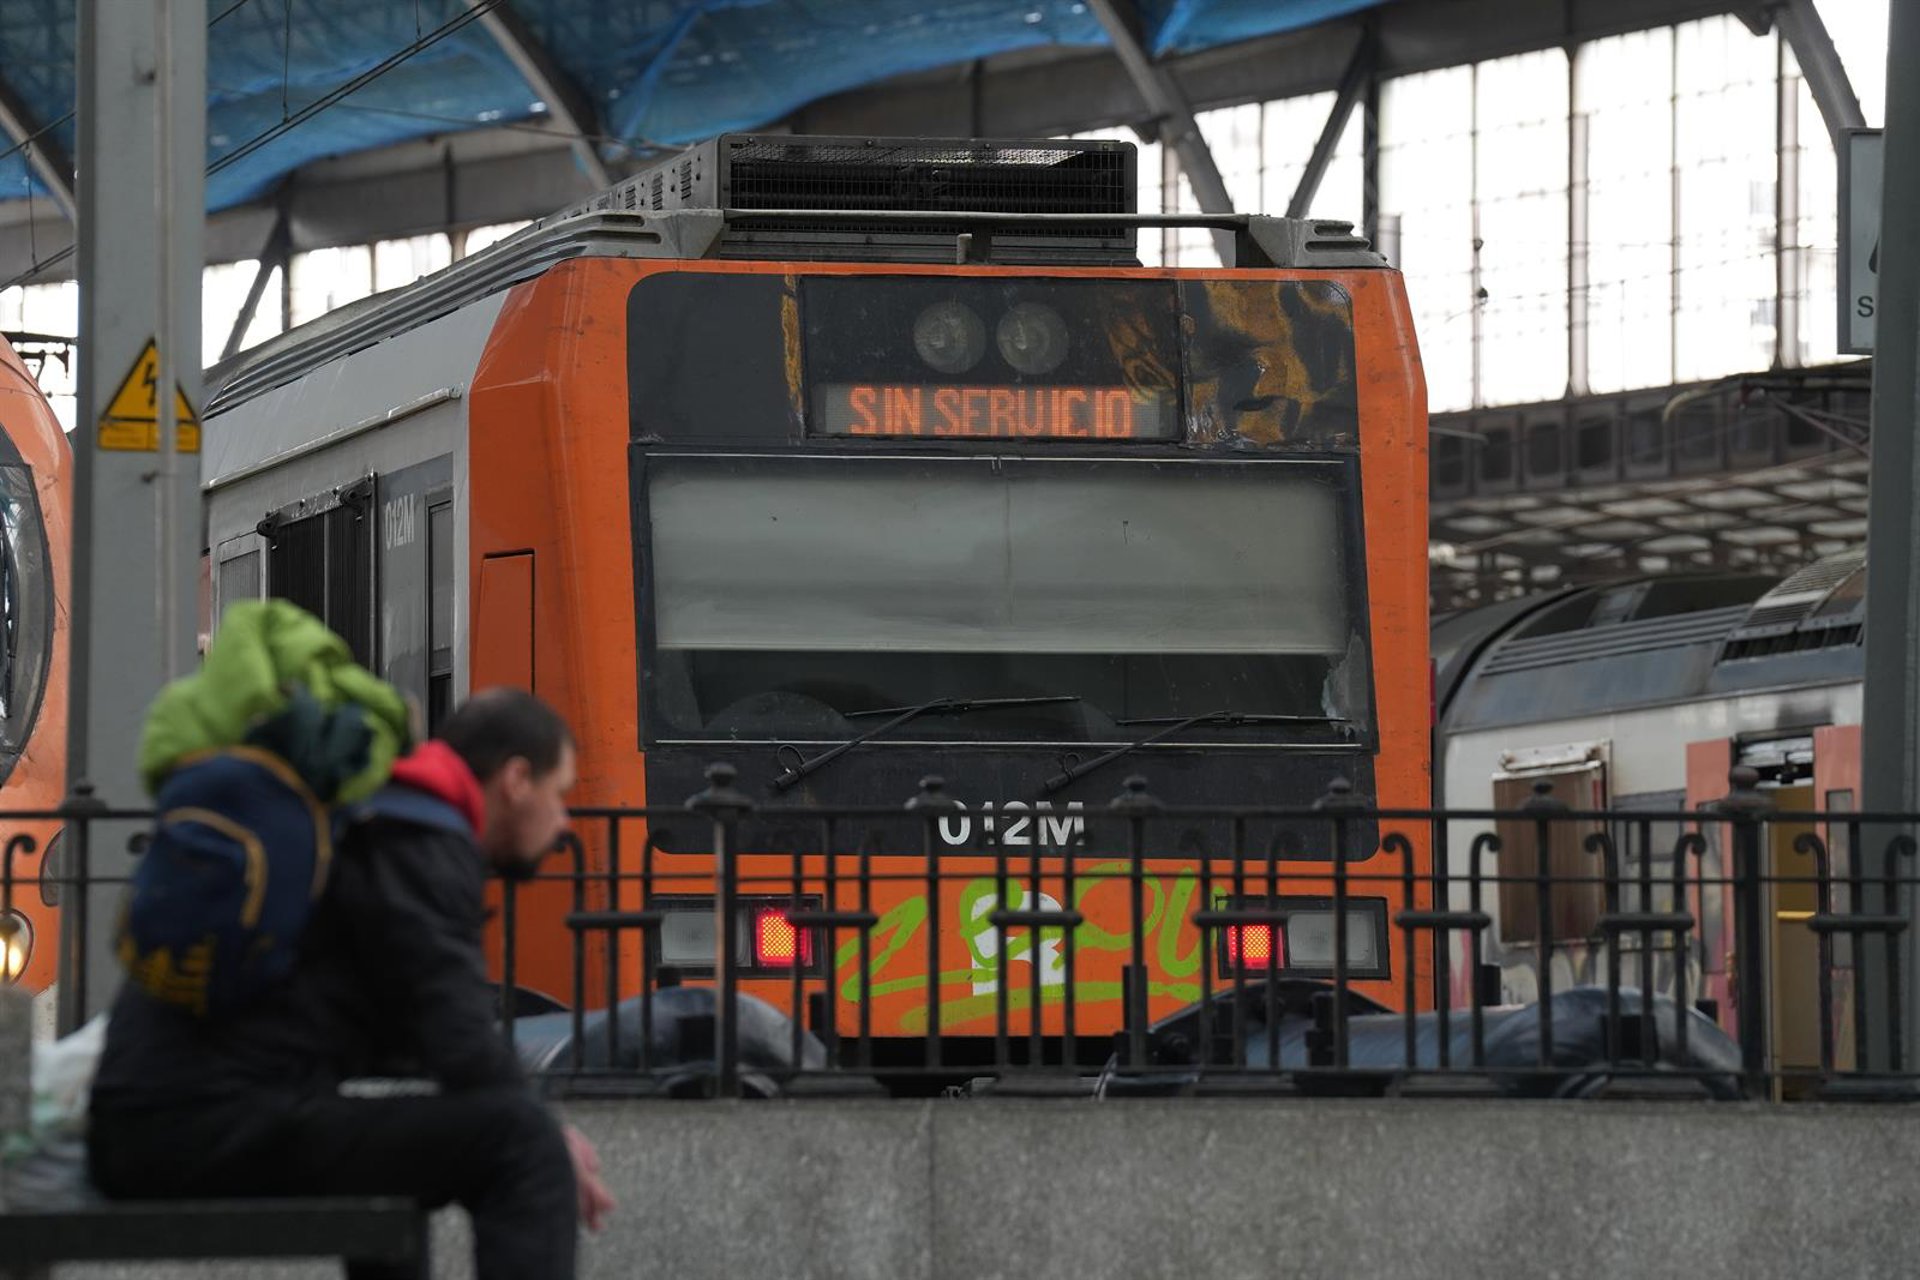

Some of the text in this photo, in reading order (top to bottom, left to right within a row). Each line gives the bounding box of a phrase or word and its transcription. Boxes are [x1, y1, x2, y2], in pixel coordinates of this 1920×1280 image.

[850, 387, 1133, 438] SIN SERVICIO
[385, 493, 415, 551] 012M
[938, 800, 1085, 846] 012M
